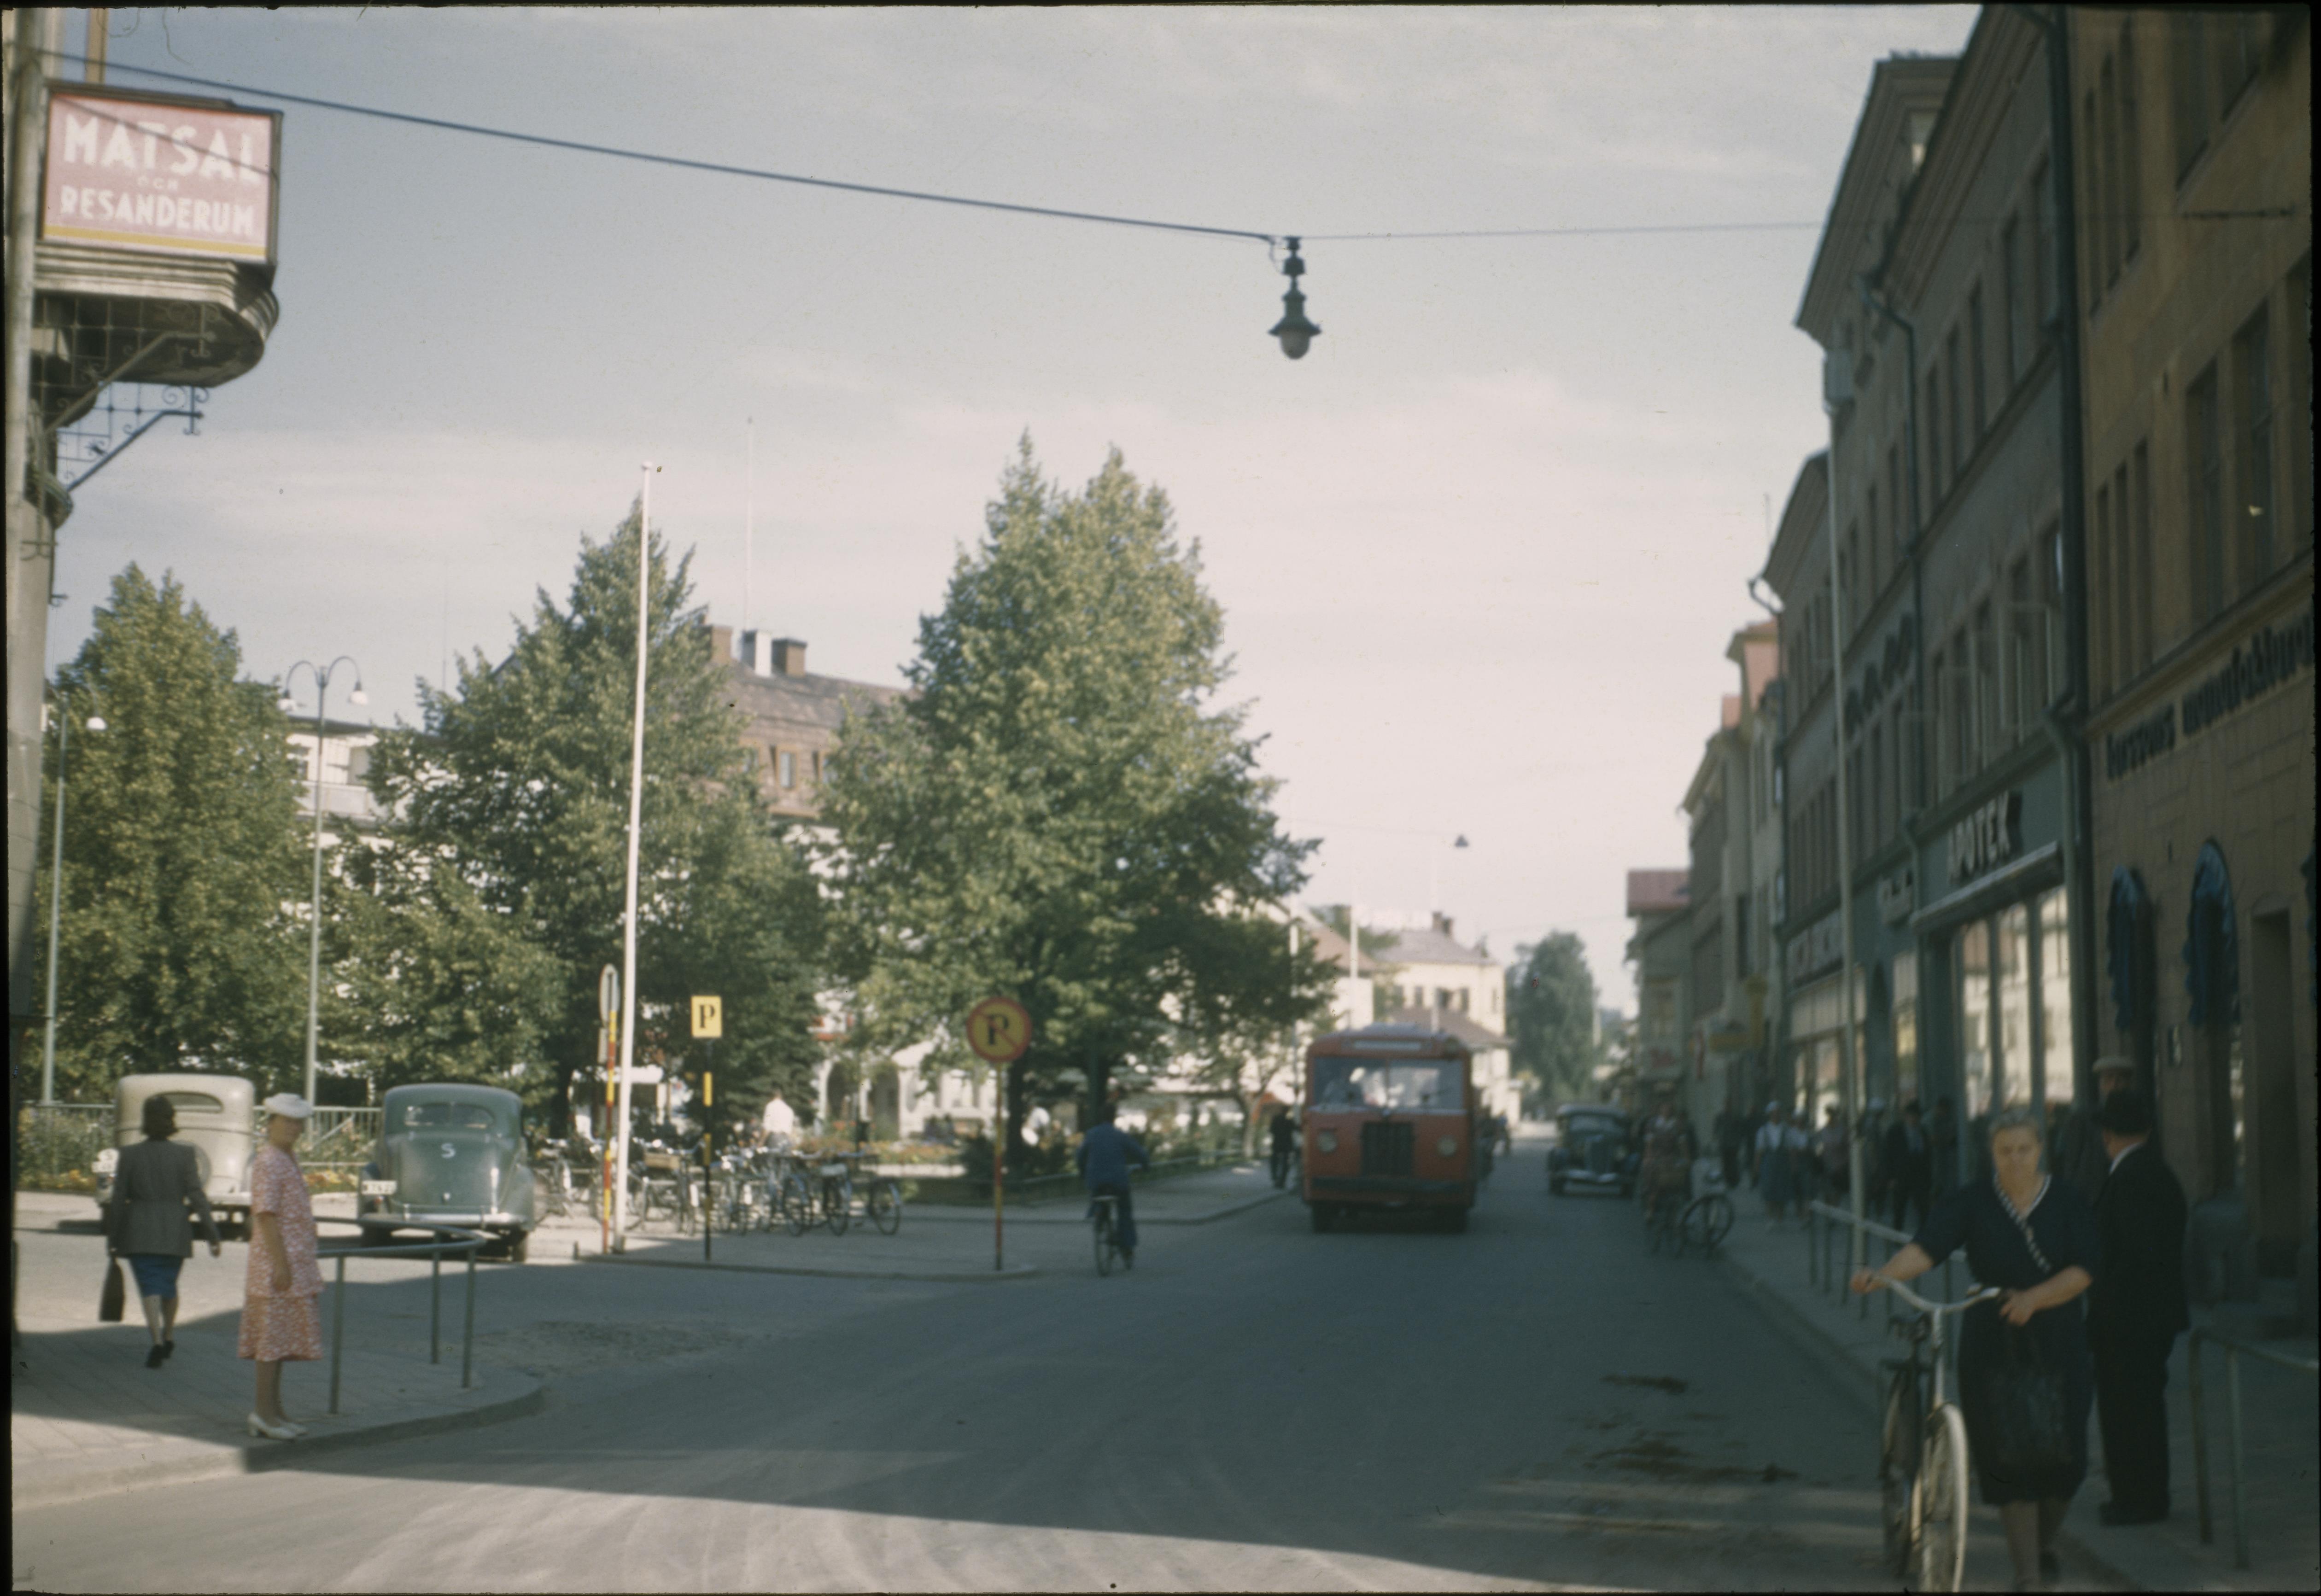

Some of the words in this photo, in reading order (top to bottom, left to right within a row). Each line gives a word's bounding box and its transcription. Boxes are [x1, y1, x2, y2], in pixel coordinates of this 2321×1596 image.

[63, 113, 261, 182] MATSAL
[60, 185, 254, 235] RESANDERUM
[699, 1004, 715, 1029] P
[987, 1014, 1009, 1046] P
